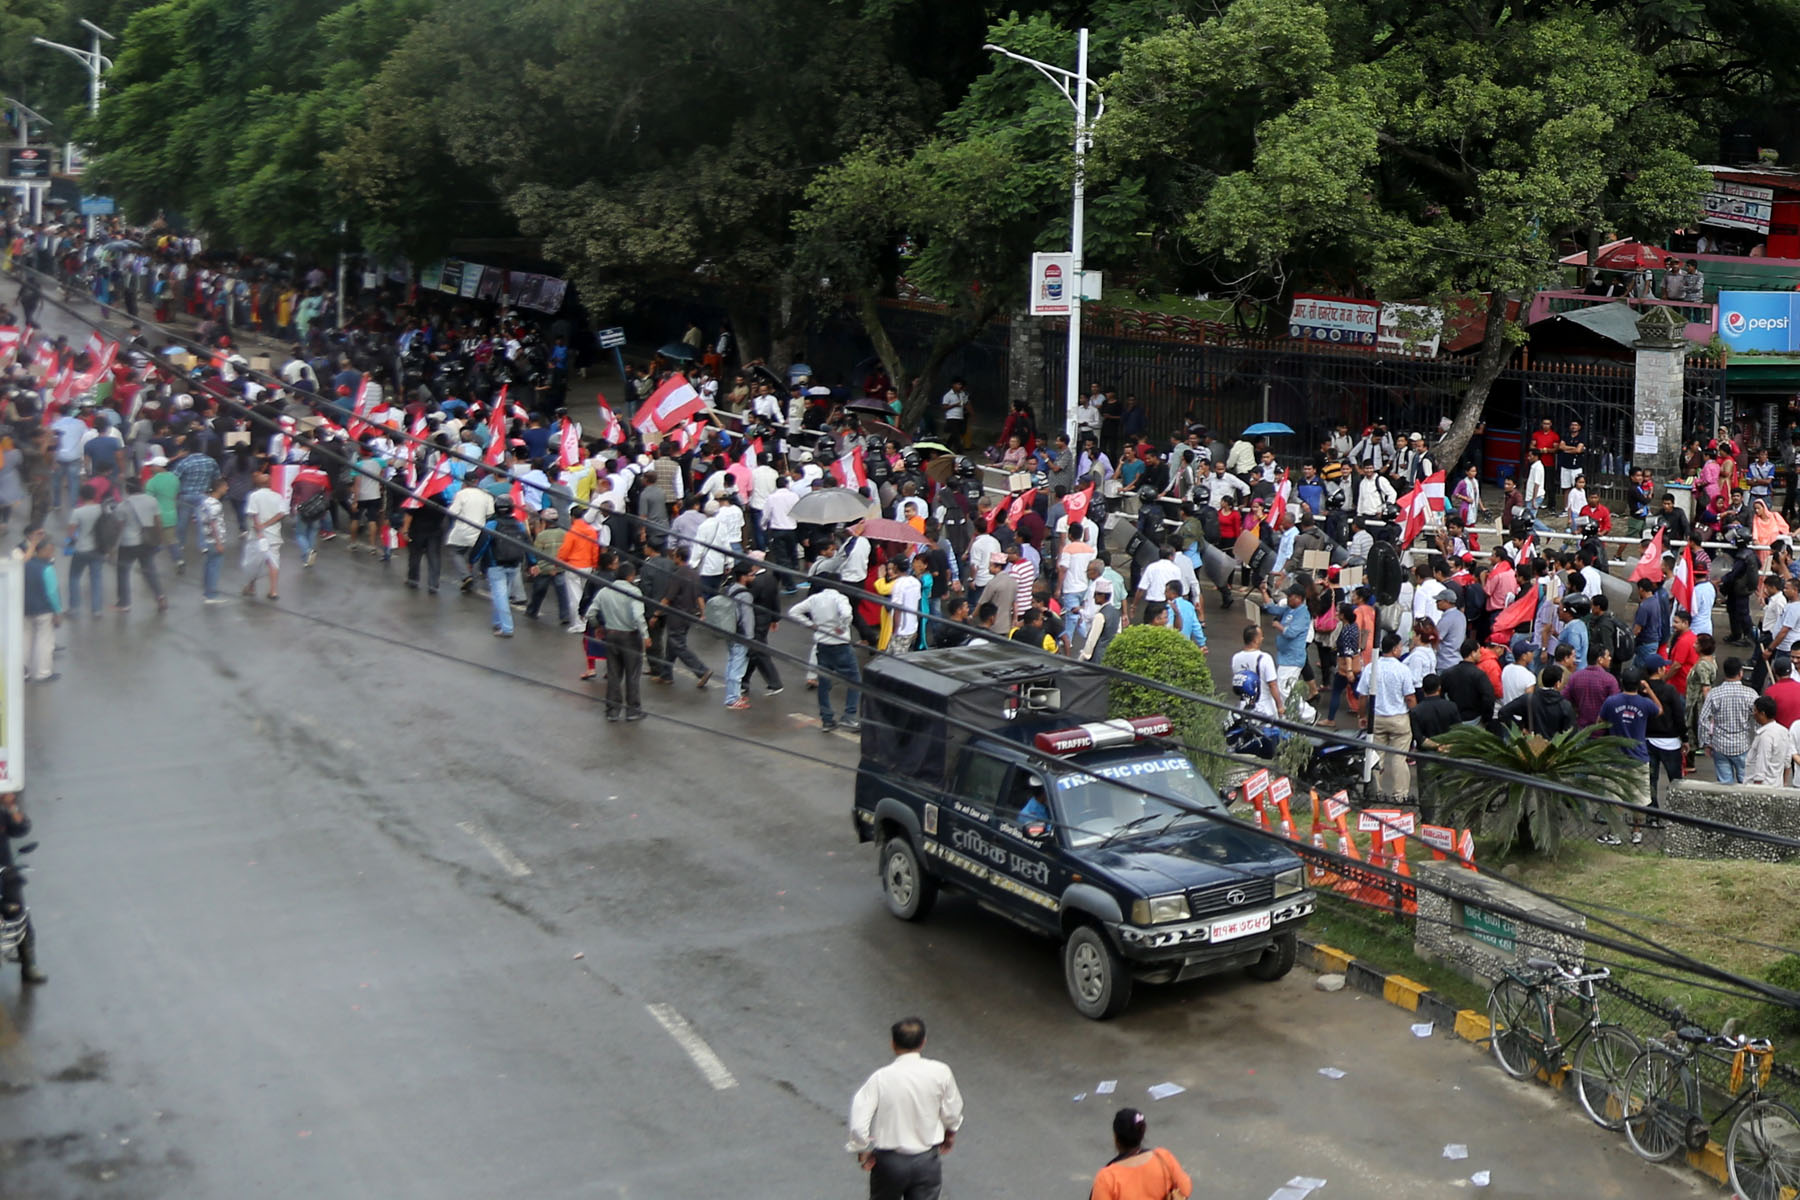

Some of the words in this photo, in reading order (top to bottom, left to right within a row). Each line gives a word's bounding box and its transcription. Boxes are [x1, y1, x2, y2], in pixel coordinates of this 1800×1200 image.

[1748, 316, 1790, 332] pepsi
[1055, 737, 1092, 751] TRAFFIC
[1136, 723, 1170, 736] POLICE
[1131, 758, 1191, 776] POLICE
[952, 827, 1008, 865] ट्राफिक
[1009, 852, 1050, 885] प्रहरी
